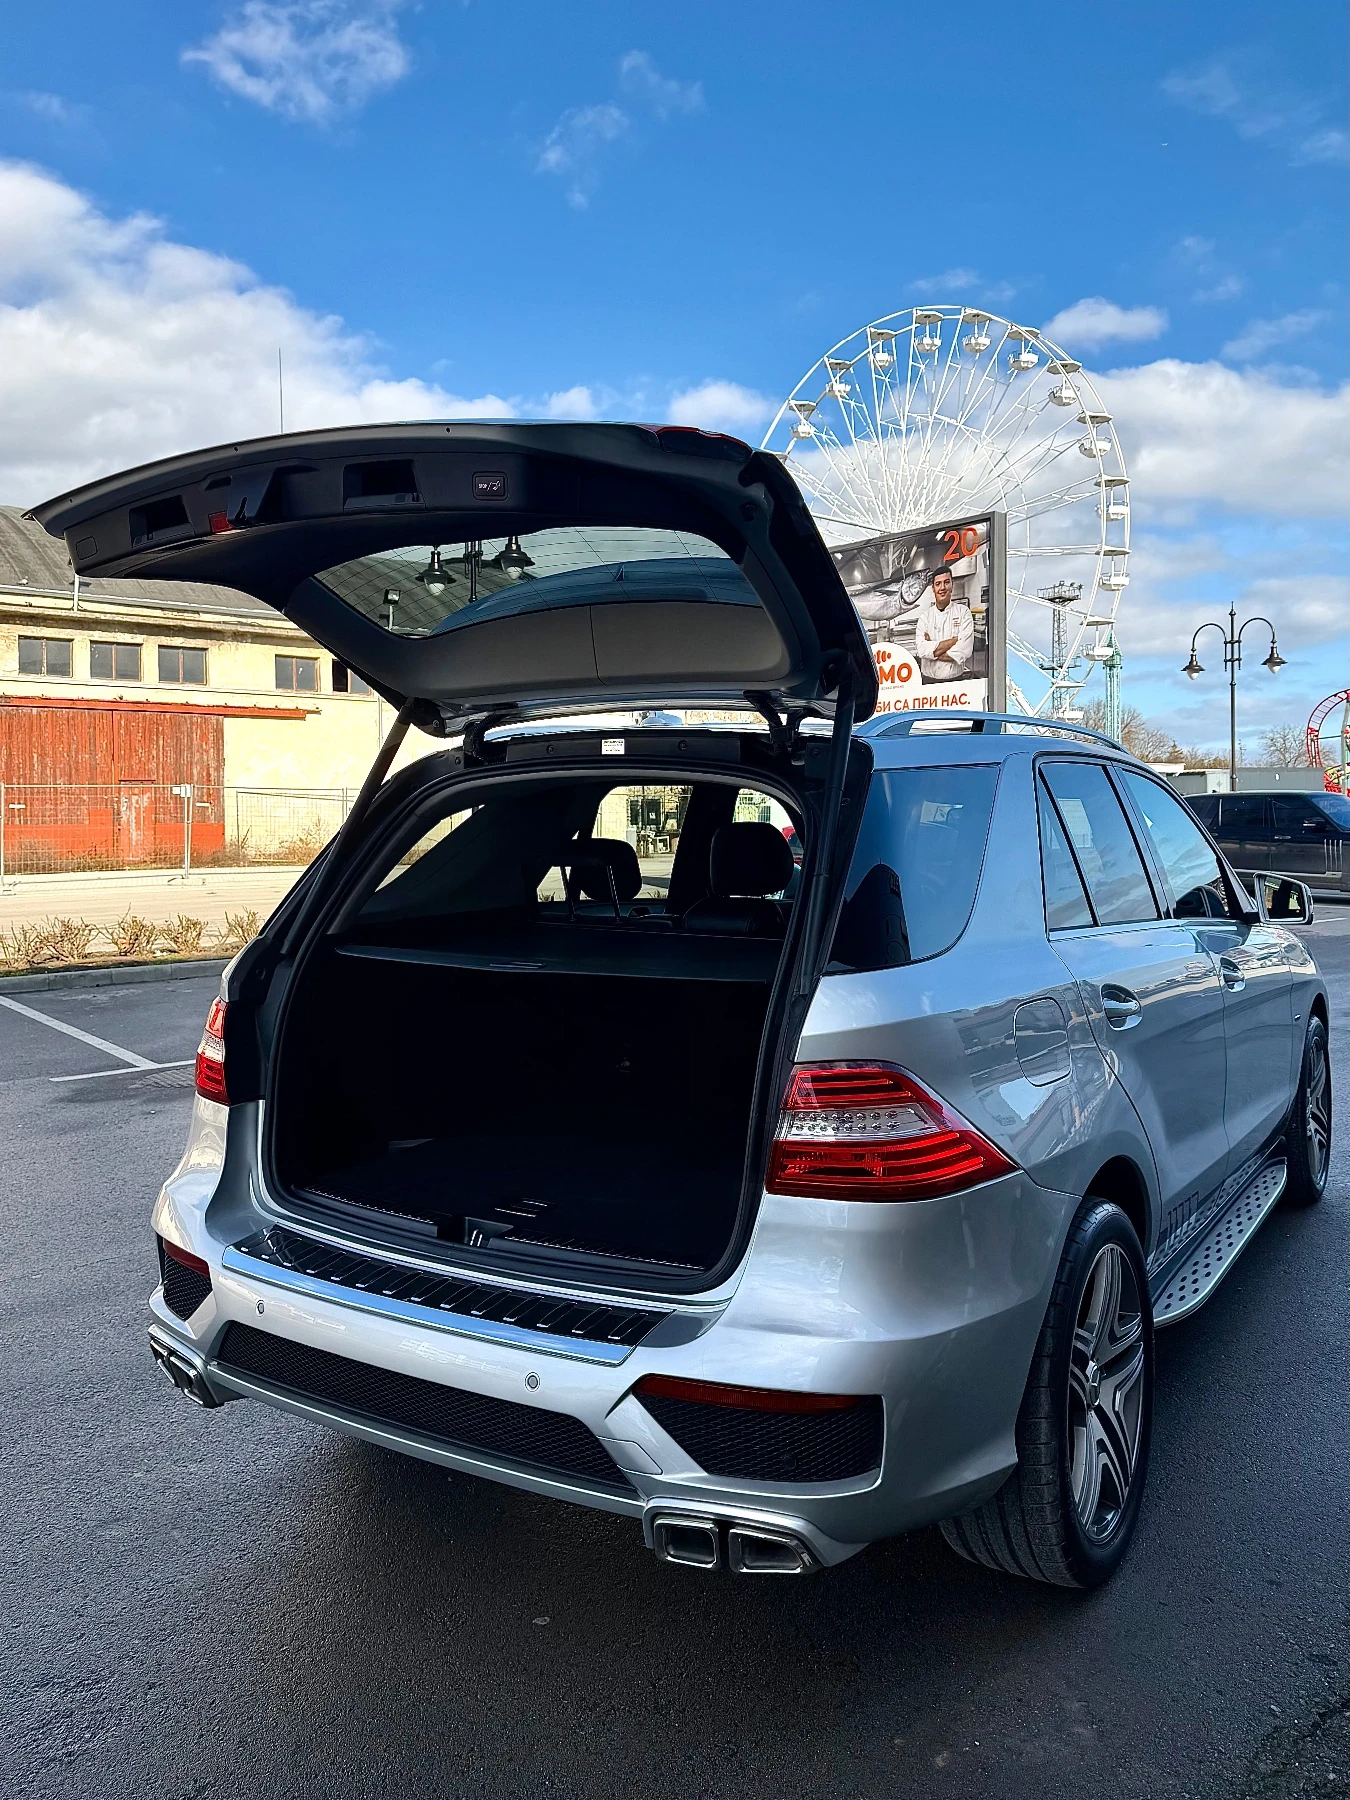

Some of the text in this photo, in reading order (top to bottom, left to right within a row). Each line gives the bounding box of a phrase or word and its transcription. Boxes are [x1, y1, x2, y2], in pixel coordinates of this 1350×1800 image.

[893, 699, 910, 711] СА
[912, 695, 938, 709] ПРИ
[941, 692, 971, 707] НАС.
